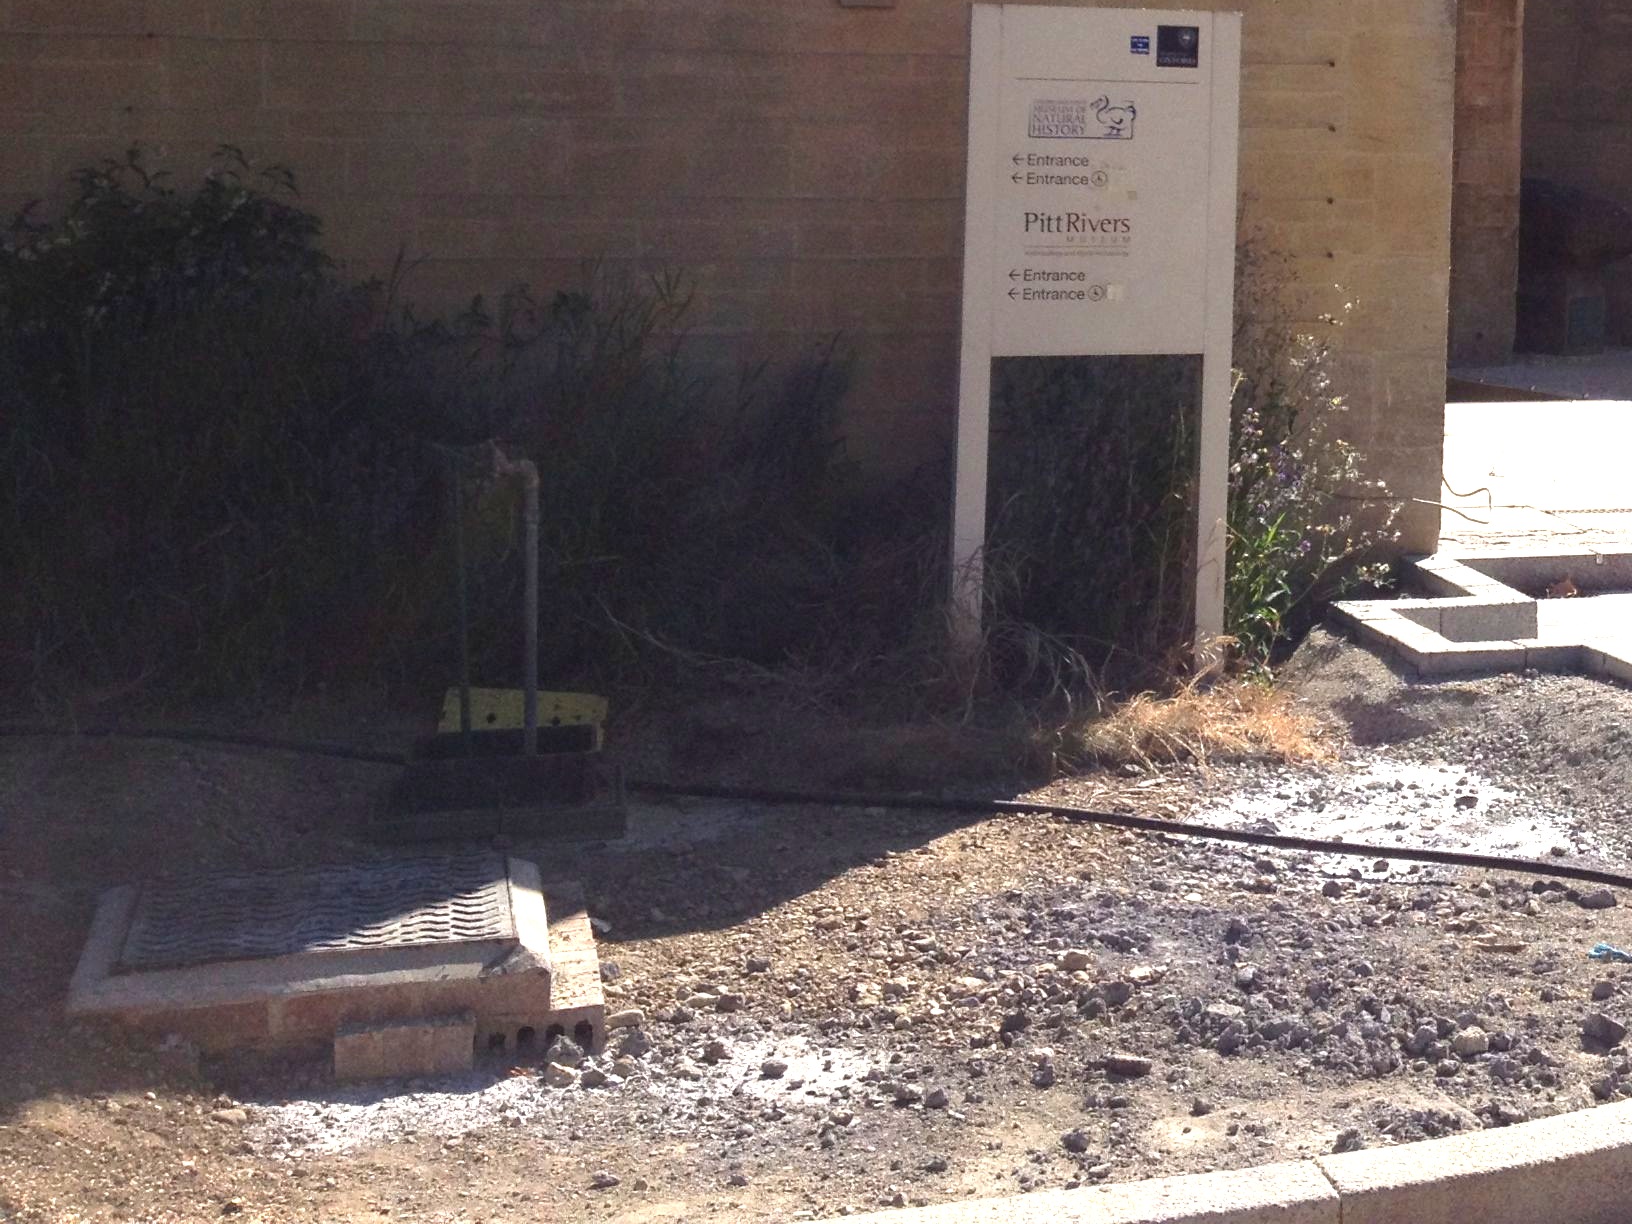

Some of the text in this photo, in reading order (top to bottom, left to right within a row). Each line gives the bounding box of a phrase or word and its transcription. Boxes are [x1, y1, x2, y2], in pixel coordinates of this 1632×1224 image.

[1033, 113, 1086, 124] NATURAL
[1032, 124, 1086, 136] HISTORY
[1027, 153, 1089, 167] Entrance
[1026, 172, 1089, 185] Entrance
[1024, 212, 1131, 233] Pitt Rivers
[1023, 268, 1085, 282] Entrance
[1022, 287, 1085, 301] Entrance
